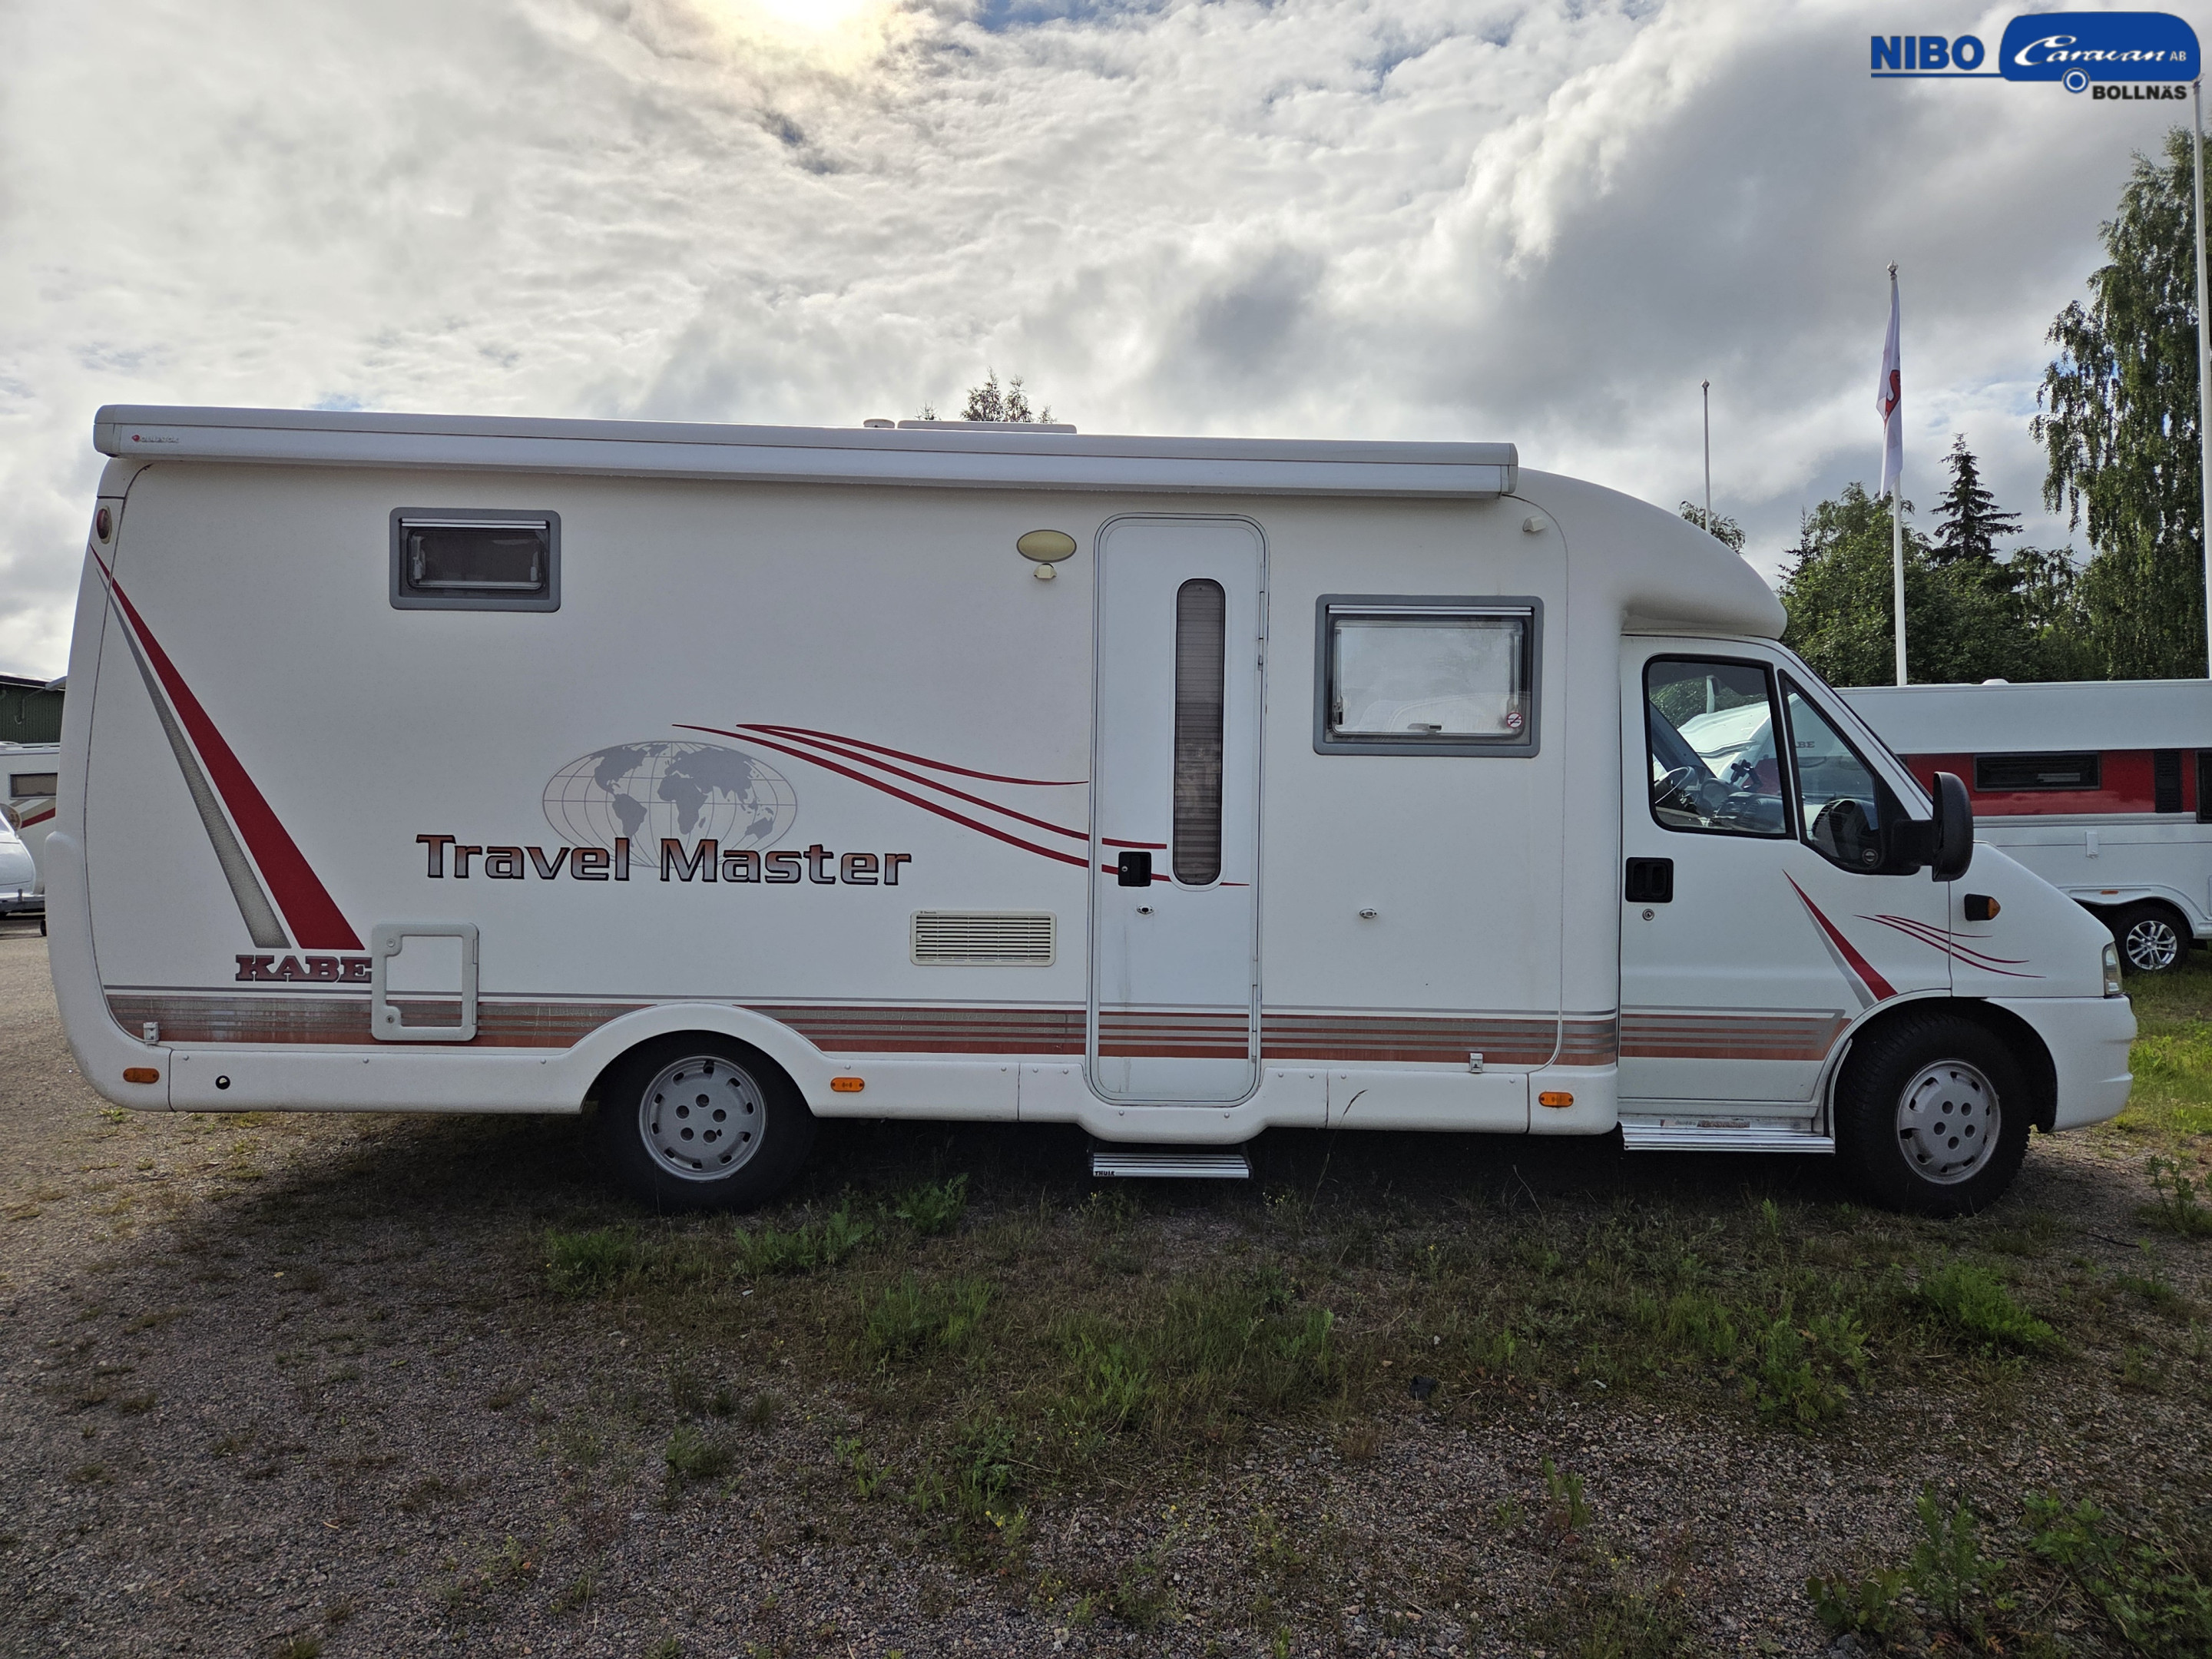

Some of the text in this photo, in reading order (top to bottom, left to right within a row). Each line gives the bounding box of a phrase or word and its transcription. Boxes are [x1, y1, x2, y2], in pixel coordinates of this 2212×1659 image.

[416, 834, 912, 886] Travel Master
[235, 954, 372, 984] KABE
